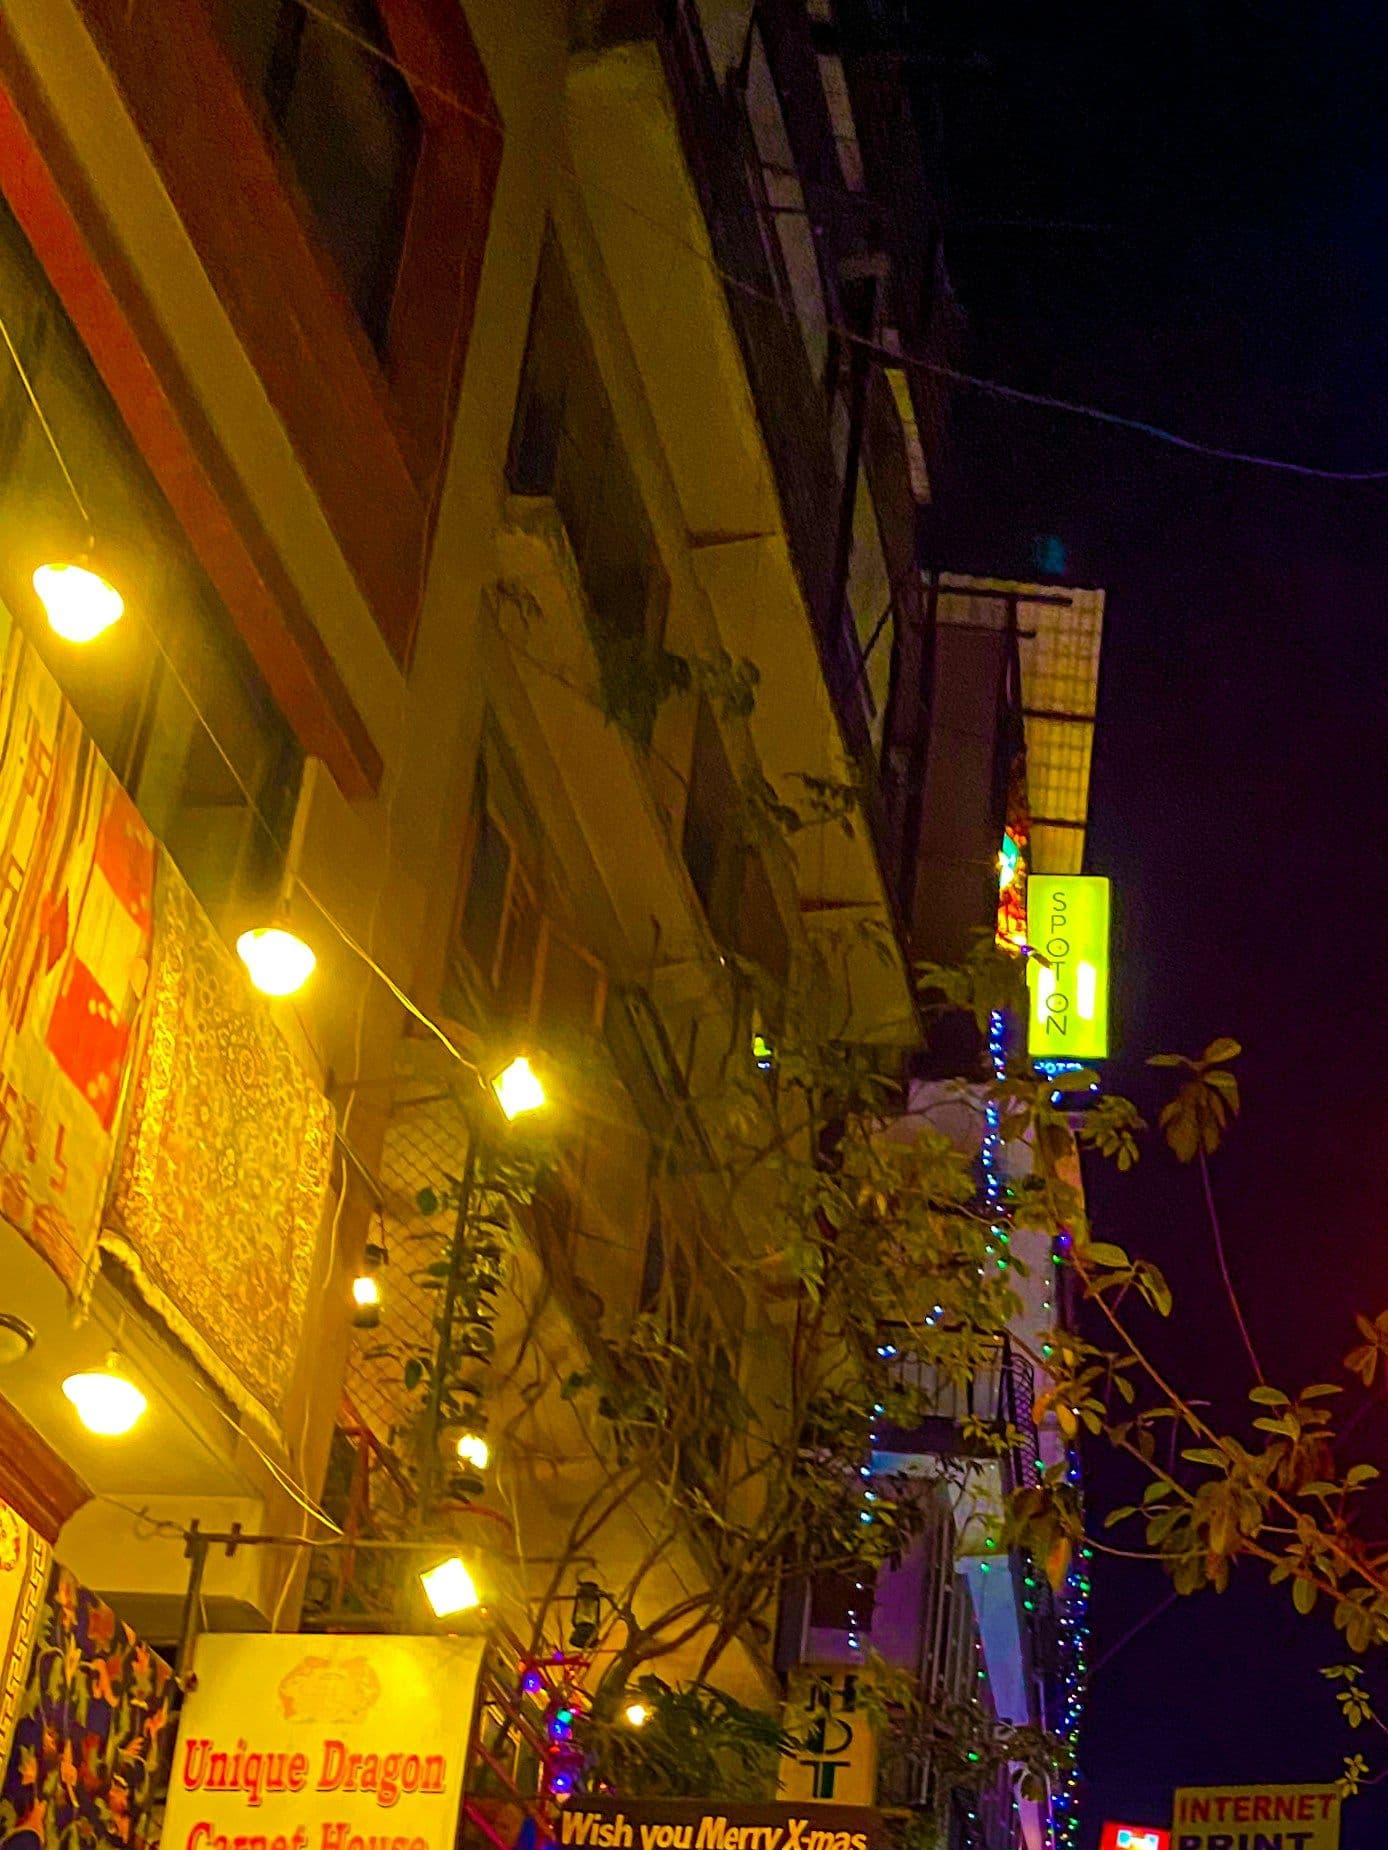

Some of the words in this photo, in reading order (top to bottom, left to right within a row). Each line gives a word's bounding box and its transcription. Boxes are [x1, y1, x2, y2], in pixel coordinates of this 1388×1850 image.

[1046, 892, 1069, 981] SPOT
[1046, 993, 1069, 1035] ON
[183, 1738, 308, 1806] Unique
[316, 1740, 447, 1807] Dragon
[1180, 1793, 1336, 1823] INTERNET
[561, 1811, 632, 1848] Wish
